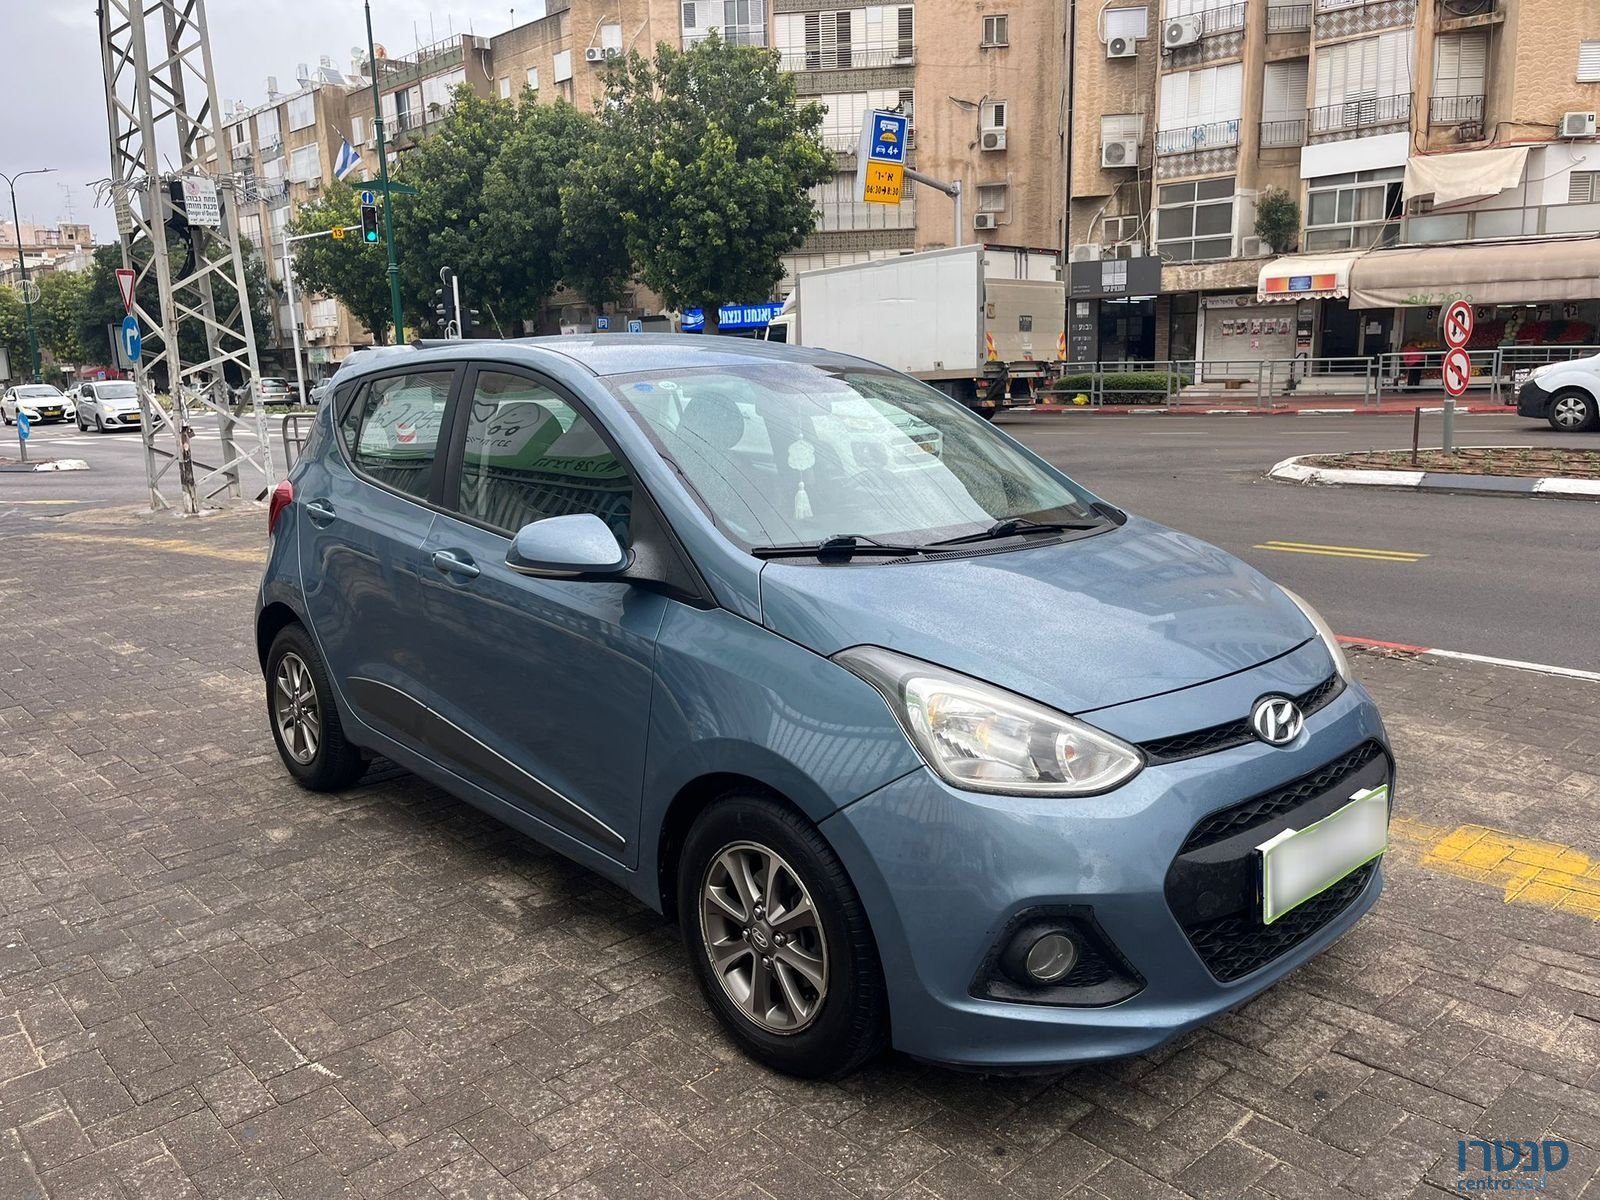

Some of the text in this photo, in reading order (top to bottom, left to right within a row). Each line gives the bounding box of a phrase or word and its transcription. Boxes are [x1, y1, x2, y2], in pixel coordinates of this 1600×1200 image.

[333, 229, 343, 237] 13
[718, 308, 741, 325] ננצח!
[744, 307, 771, 323] ואנחנו
[1426, 309, 1434, 320] 8
